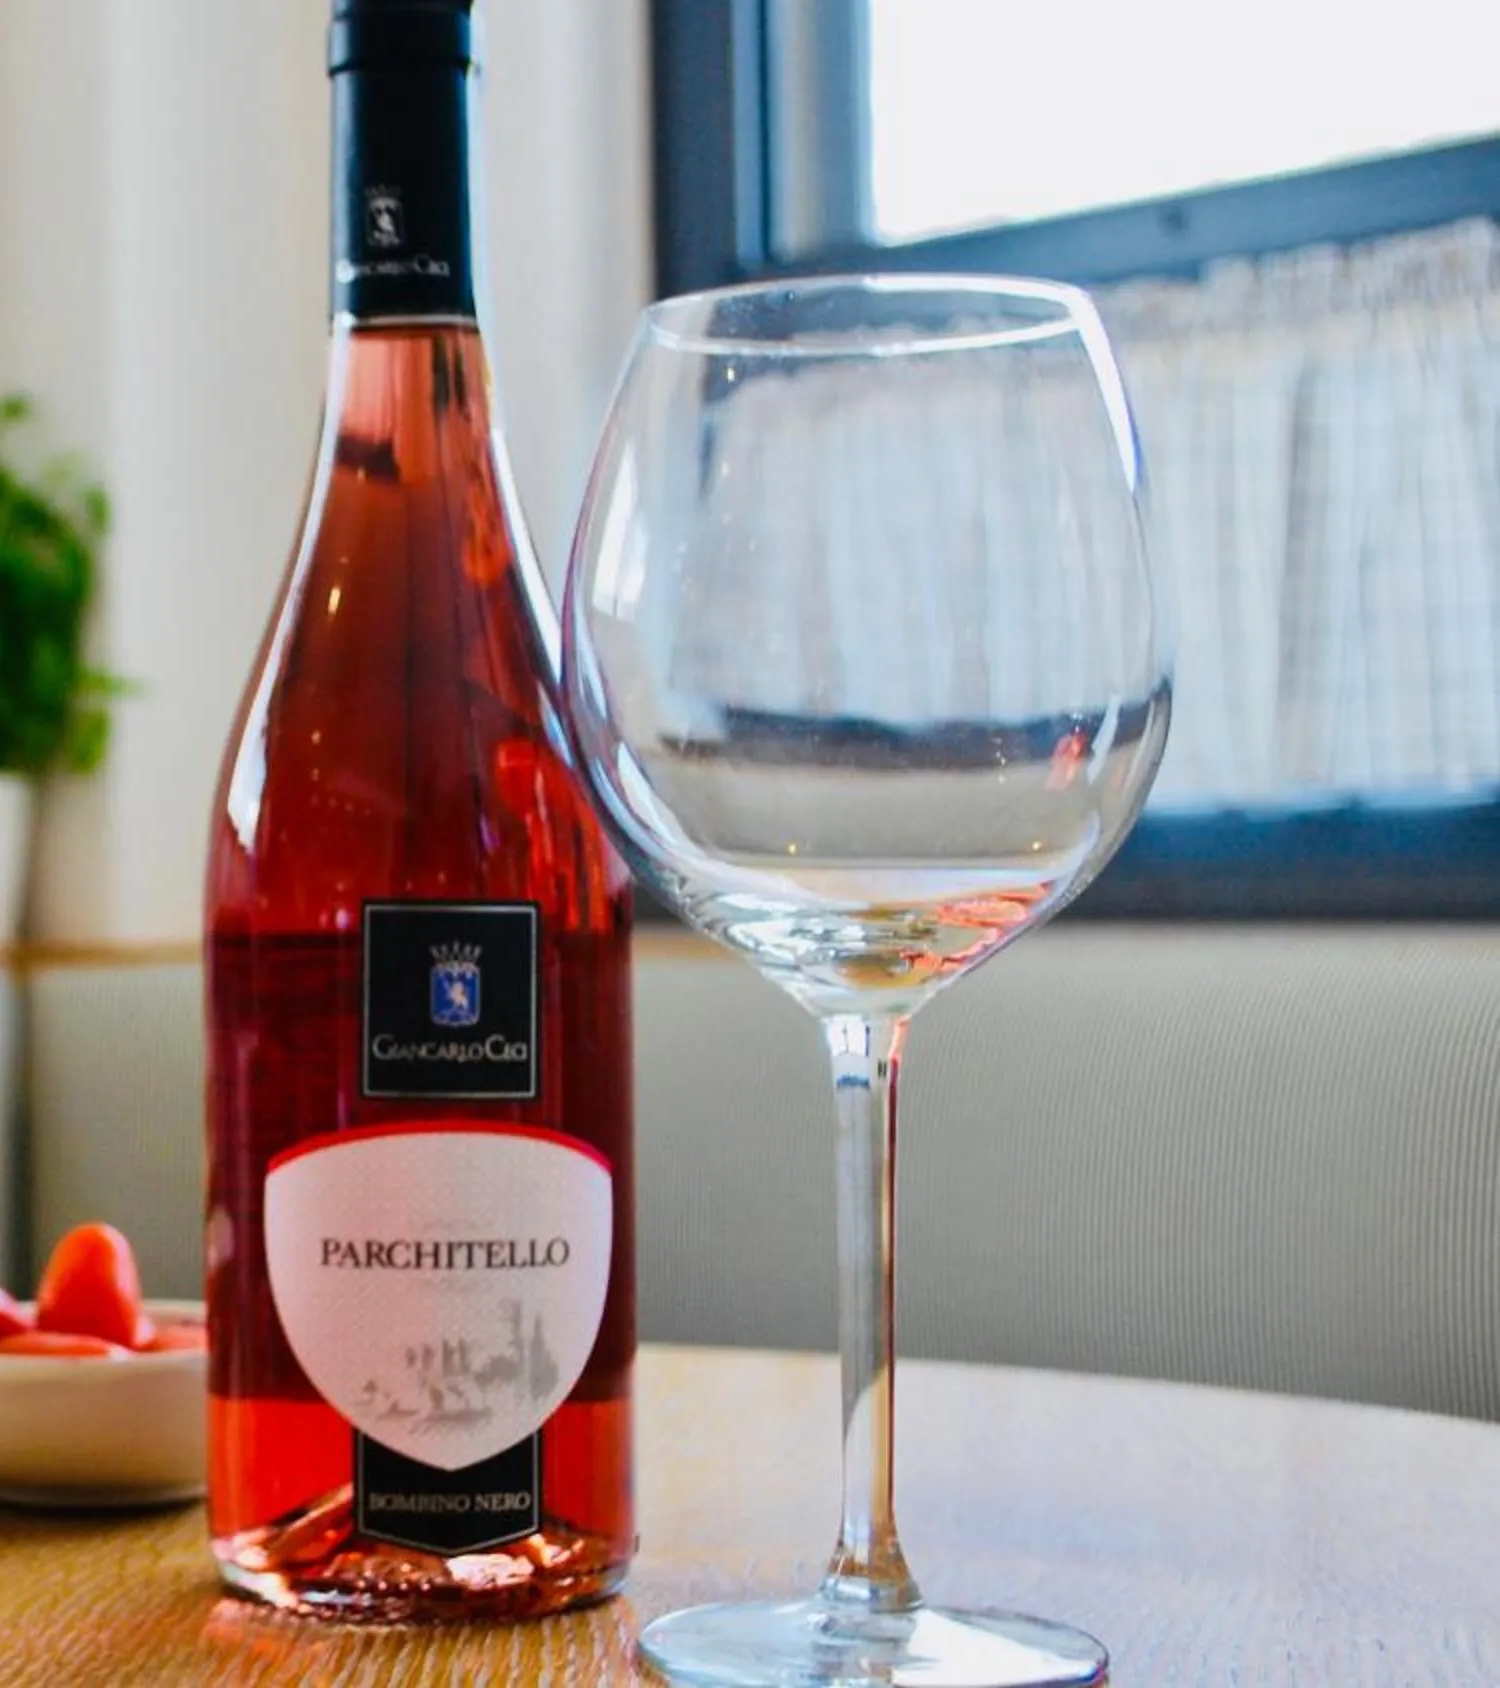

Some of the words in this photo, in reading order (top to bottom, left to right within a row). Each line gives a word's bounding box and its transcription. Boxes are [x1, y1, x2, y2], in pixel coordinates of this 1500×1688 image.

[320, 1237, 570, 1270] PARCHITELLO
[368, 1491, 470, 1513] BOMBINO
[475, 1490, 531, 1512] NERO
